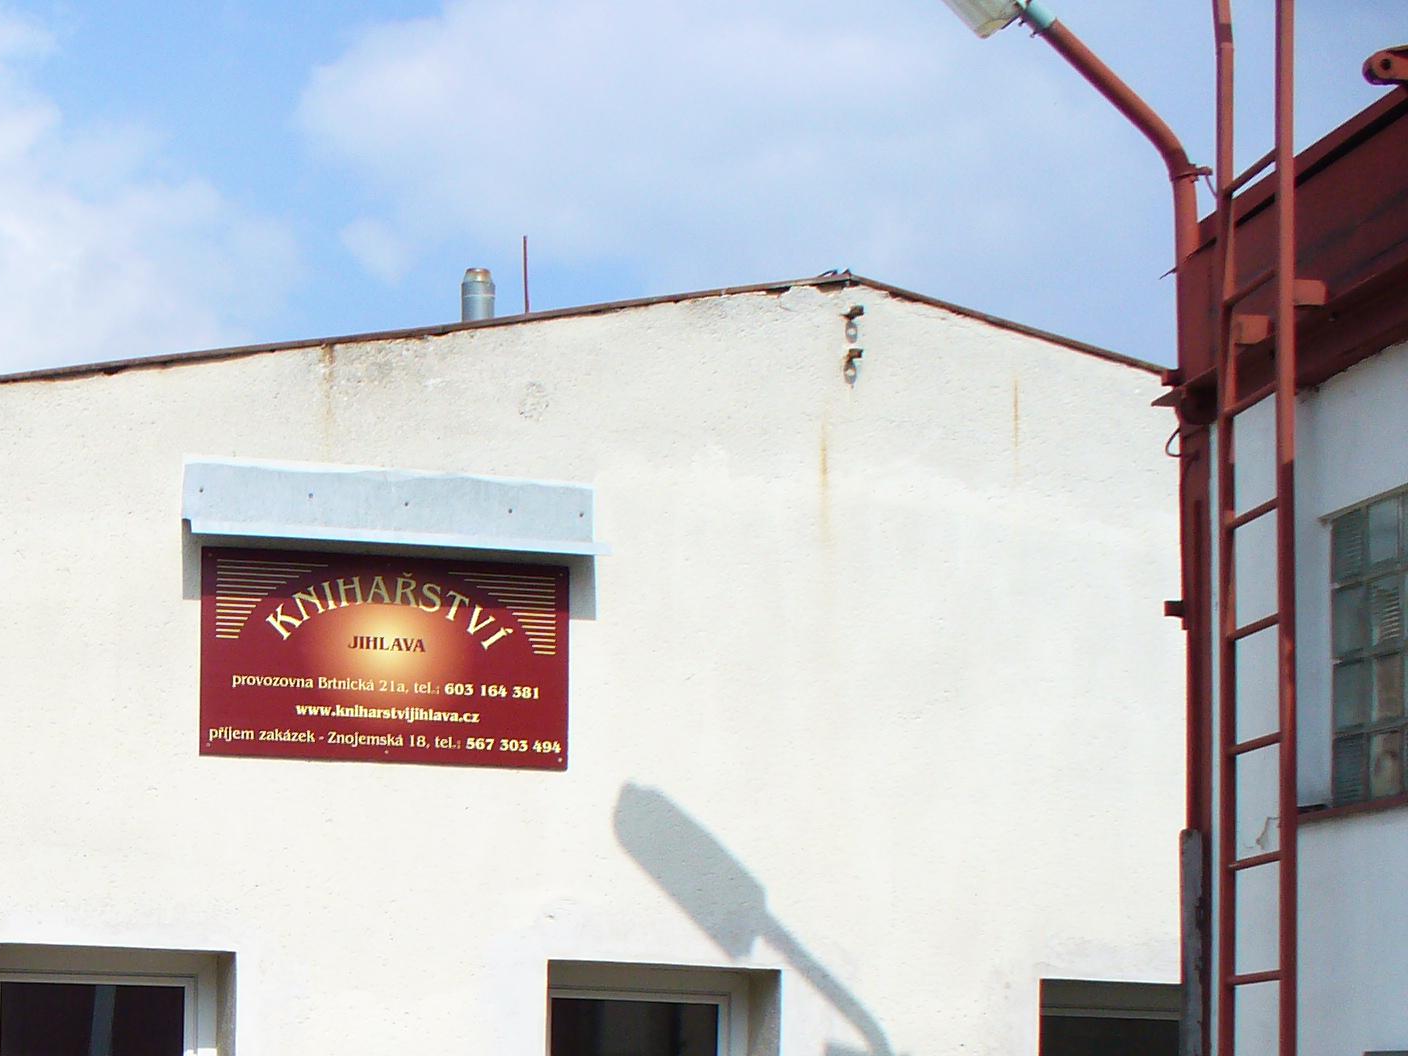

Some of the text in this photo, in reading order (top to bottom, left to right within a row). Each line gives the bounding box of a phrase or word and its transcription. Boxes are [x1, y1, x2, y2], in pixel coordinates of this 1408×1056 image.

[265, 571, 514, 651] KNIHAŘSTVÍ
[348, 634, 426, 653] JIHLAVA
[231, 674, 540, 700] provozovna Brtnická 21a, tel.: 603 164 381
[295, 703, 480, 724] www.kniharstvijihlava.cz
[208, 726, 255, 742] příjem
[258, 728, 316, 744] zakázek
[327, 731, 404, 748] Znojemská
[409, 734, 431, 750] 18,
[434, 735, 461, 750] tel.:
[465, 737, 495, 751] 567
[499, 738, 528, 752] 303
[533, 740, 562, 754] 494
